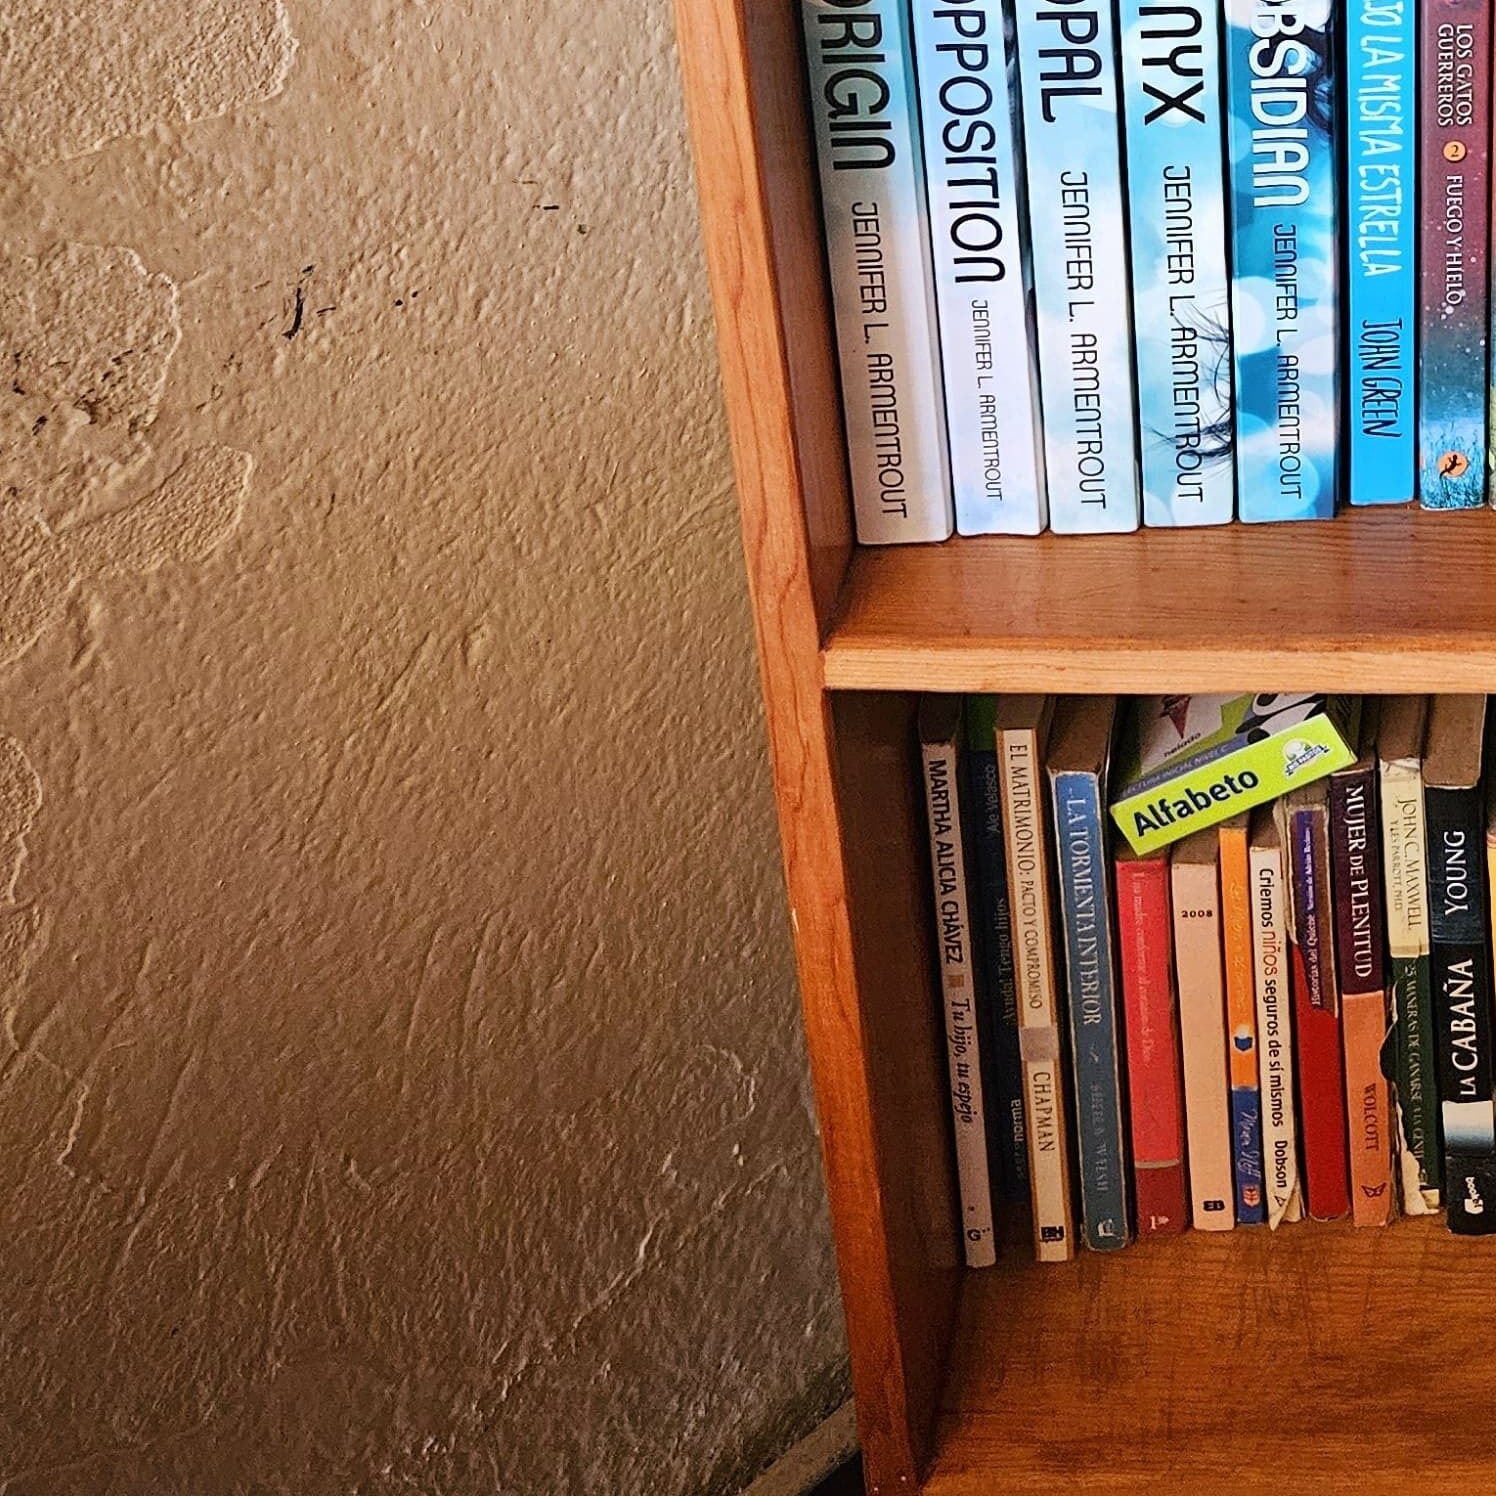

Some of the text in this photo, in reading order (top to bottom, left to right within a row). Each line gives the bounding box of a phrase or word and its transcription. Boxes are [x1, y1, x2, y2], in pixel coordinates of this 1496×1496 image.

[1357, 74, 1403, 155] MISMA
[1360, 35, 1403, 67] LA
[1437, 23, 1453, 126] GUERREROS
[1455, 23, 1472, 126] LOS GATOS
[1356, 163, 1403, 277] ESTRELLA
[1445, 174, 1462, 304] FUEGO Y HIELO
[846, 199, 914, 520] JENNIFER L. ARMENTROUT
[1056, 169, 1112, 510] JENNIFER L. ARMENTROUT
[1162, 165, 1206, 503] JENNIFER L. ARMENTROUT
[1273, 224, 1301, 499] JENNIFER L. ARMENTROUT
[1358, 318, 1402, 437] JOHN GREEN
[971, 299, 1004, 501] JENNIFER L. ARMENTROUT
[927, 759, 966, 964] MARTHA ALICIA CHÁVEZ
[1132, 769, 1260, 837] Alfabeto
[1008, 743, 1043, 1008] EL MATRIMONIO: PACTO Y COMPROMISO
[1066, 797, 1102, 1025] LA TORMENTA INTERIOR
[1181, 909, 1213, 918] 2008
[1340, 785, 1372, 977] MUJER DE PLENITUD
[1443, 830, 1469, 915] YOUNG
[950, 998, 975, 1124] Tu hijo, tu espejo
[1257, 867, 1284, 1127] Criemos niños seguros de sí mismos
[1441, 958, 1478, 1095] LA CABAÑA
[1033, 1071, 1055, 1152] CHAPMAN
[1274, 1140, 1288, 1188] Dobson
